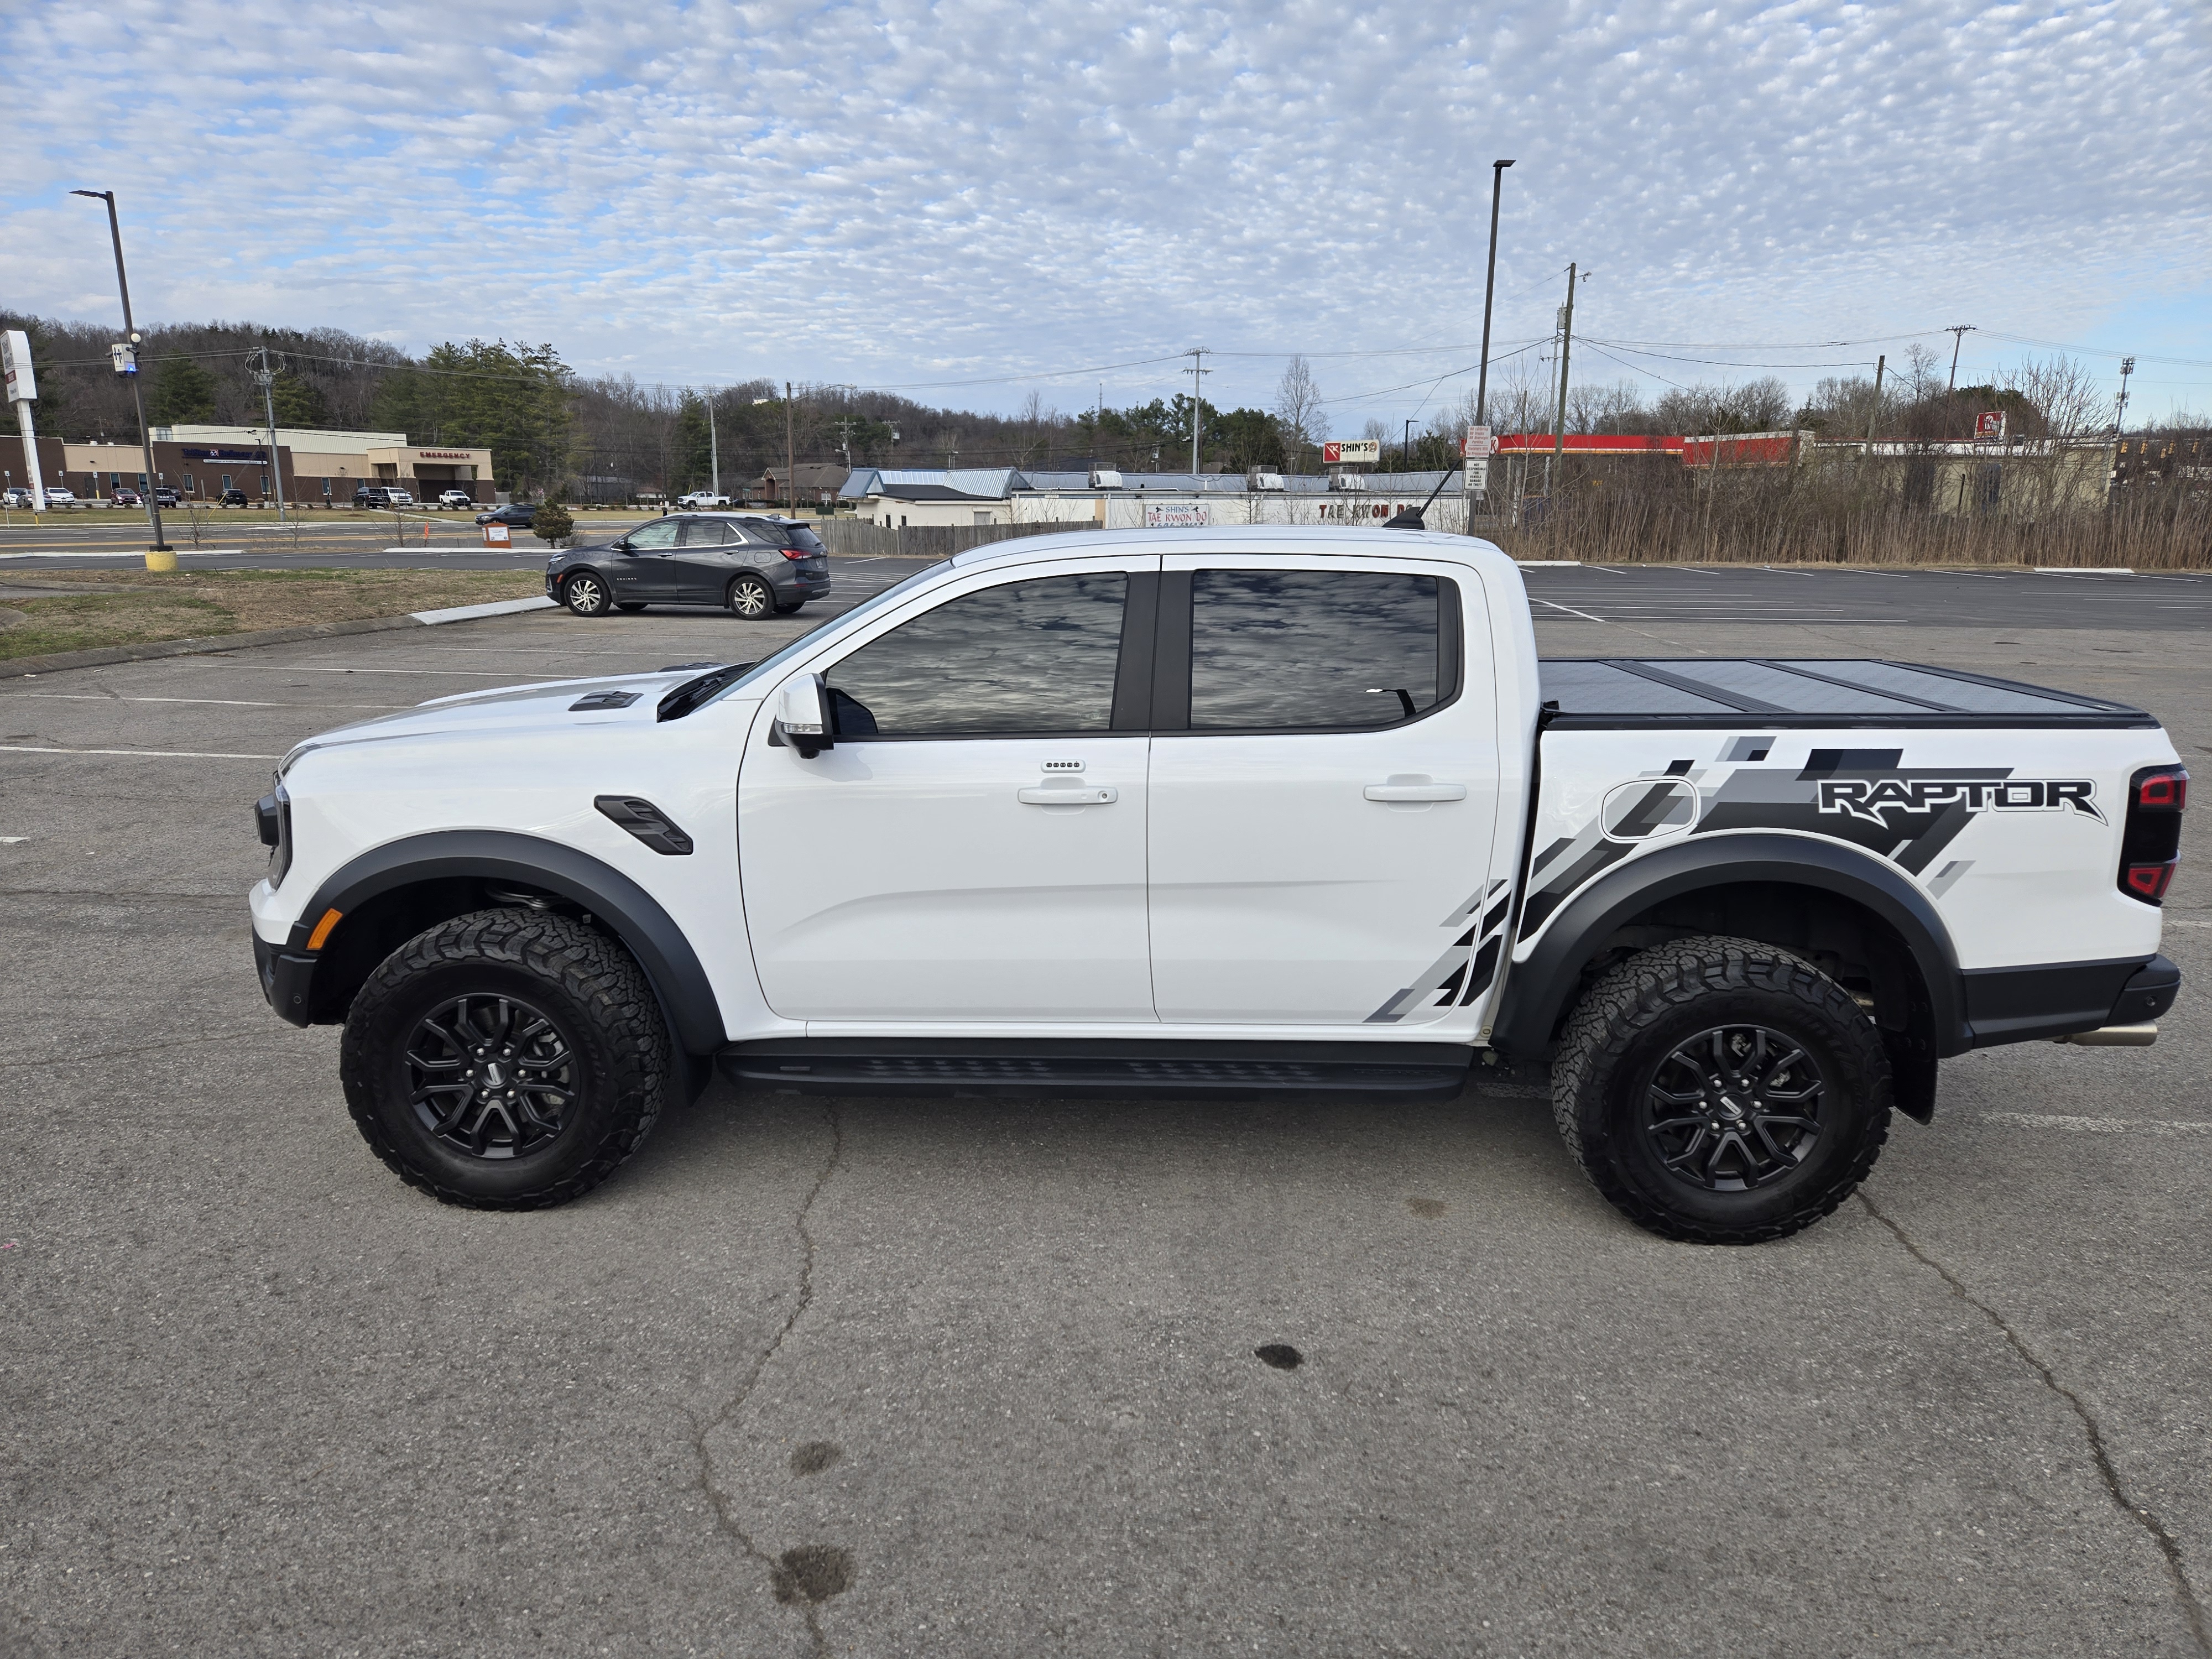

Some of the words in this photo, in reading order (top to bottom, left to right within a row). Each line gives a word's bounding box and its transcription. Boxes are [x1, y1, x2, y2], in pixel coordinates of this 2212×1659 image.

[1341, 442, 1368, 452] SHIN'S
[1490, 439, 1497, 452] K
[1147, 512, 1162, 522] TAE
[1165, 513, 1192, 522] KWON
[1196, 512, 1207, 521] DO
[1319, 504, 1345, 518] TAE
[1817, 779, 2109, 830] RAPTOR
